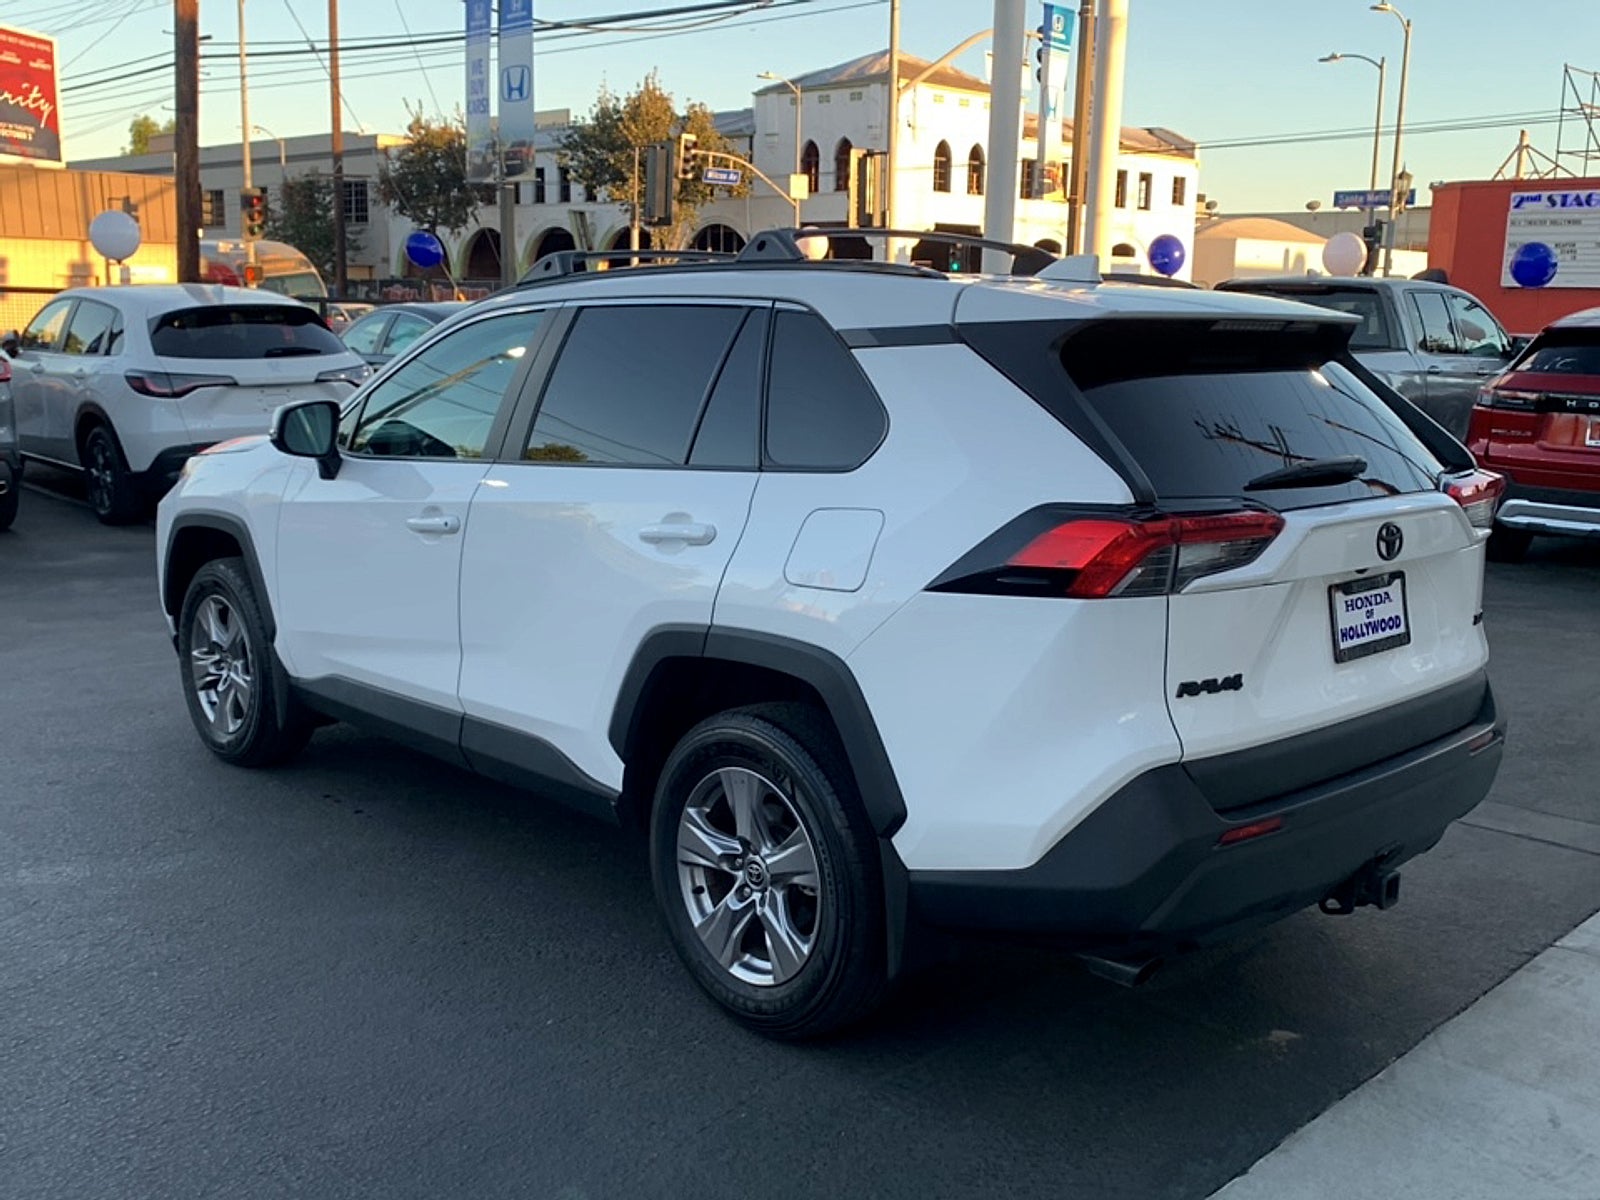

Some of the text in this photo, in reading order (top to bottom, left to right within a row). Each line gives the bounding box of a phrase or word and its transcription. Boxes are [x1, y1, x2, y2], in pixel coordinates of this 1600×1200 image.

[1512, 194, 1542, 209] 2nd
[1344, 592, 1393, 612] HONDA
[1365, 608, 1375, 619] OF
[1340, 615, 1402, 642] HOLLYWOOD
[1175, 673, 1243, 699] RAV4
